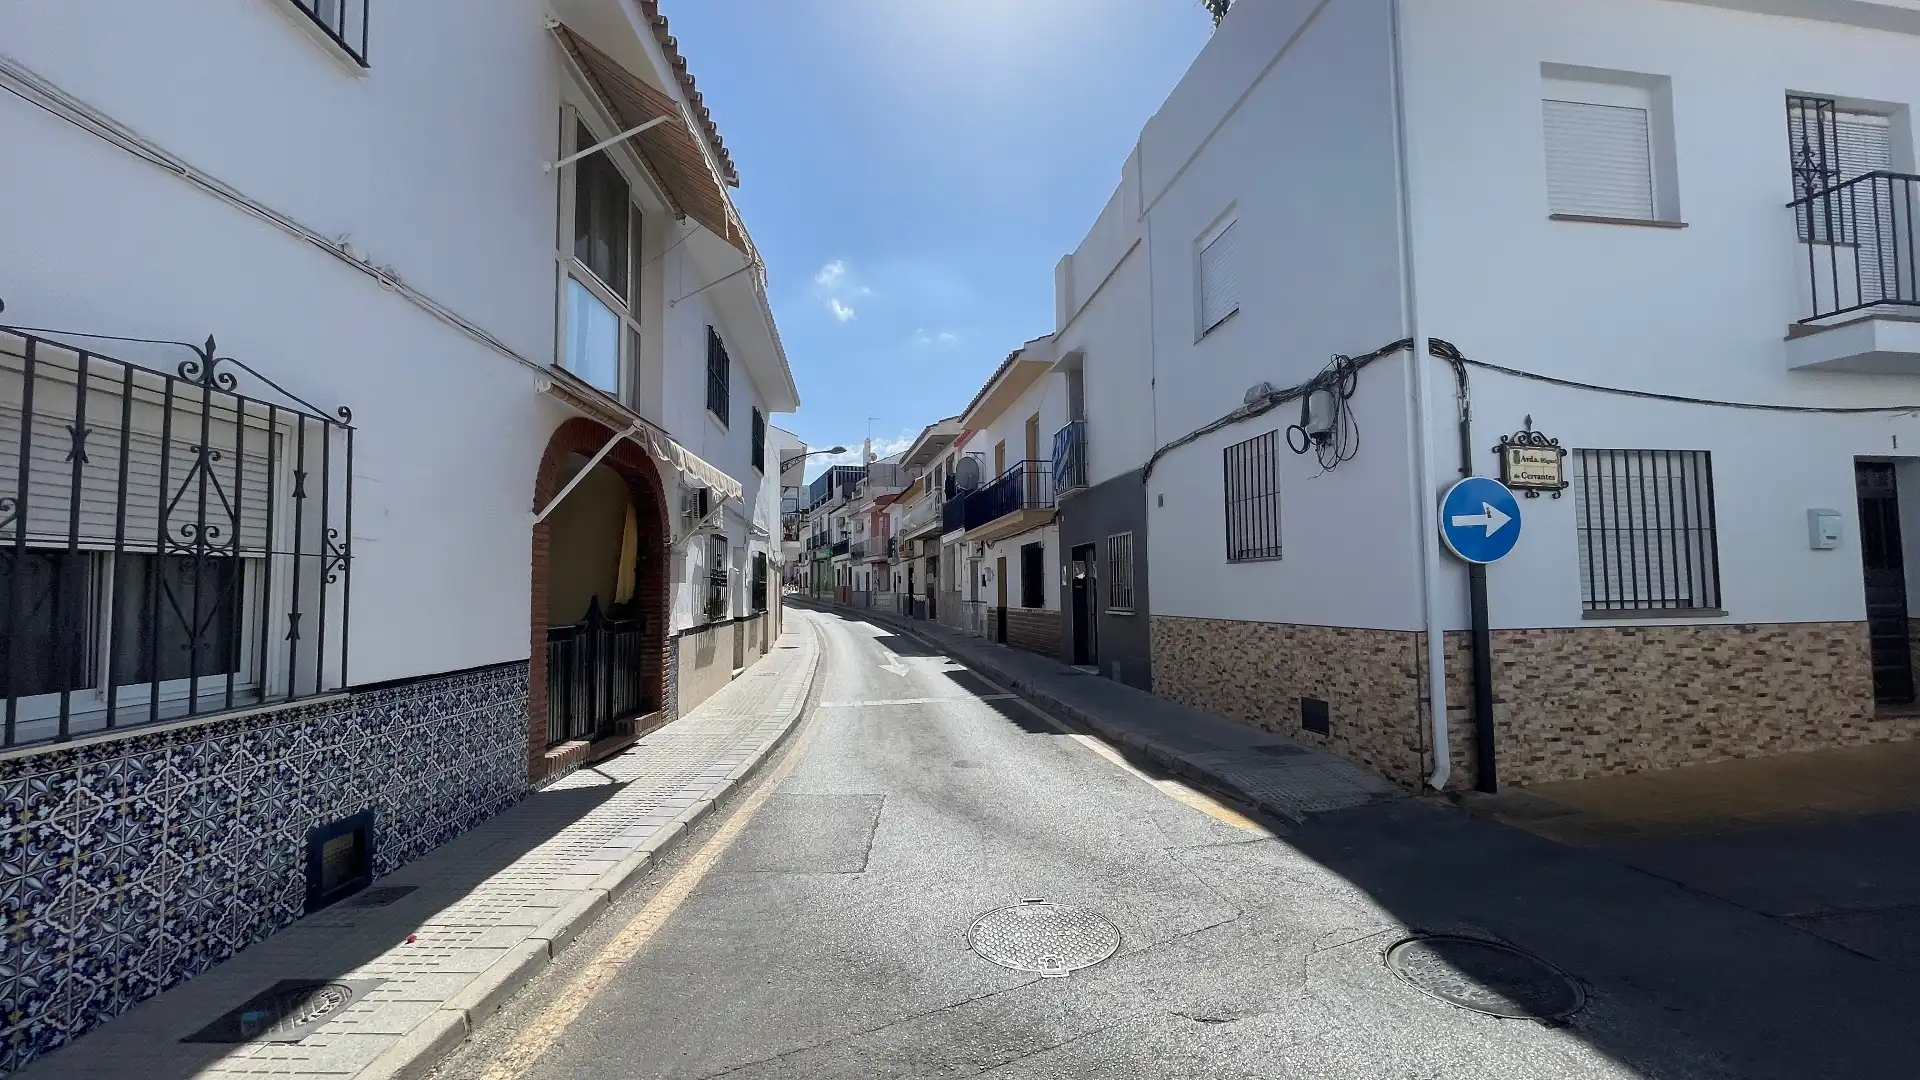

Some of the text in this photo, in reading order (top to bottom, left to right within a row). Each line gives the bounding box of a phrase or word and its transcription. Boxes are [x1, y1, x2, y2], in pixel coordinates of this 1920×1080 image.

[1891, 434, 1898, 449] 1
[1521, 455, 1539, 463] Avda.
[1521, 471, 1555, 480] Cervantes
